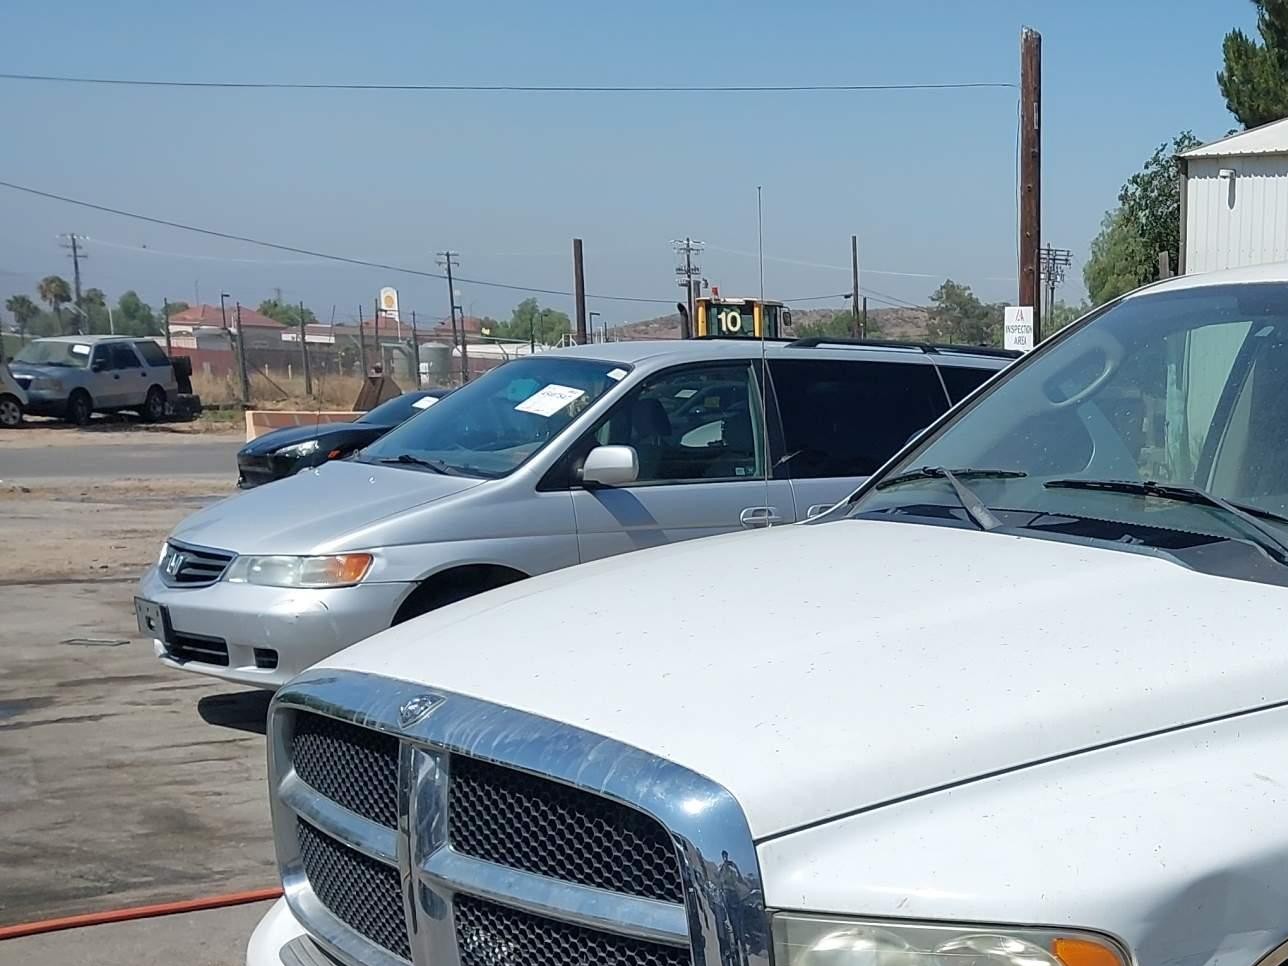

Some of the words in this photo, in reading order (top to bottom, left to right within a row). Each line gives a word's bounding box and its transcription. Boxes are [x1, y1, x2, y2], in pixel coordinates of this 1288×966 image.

[718, 311, 741, 332] 10
[1006, 324, 1032, 334] INSPECTION
[1014, 336, 1027, 345] AREA
